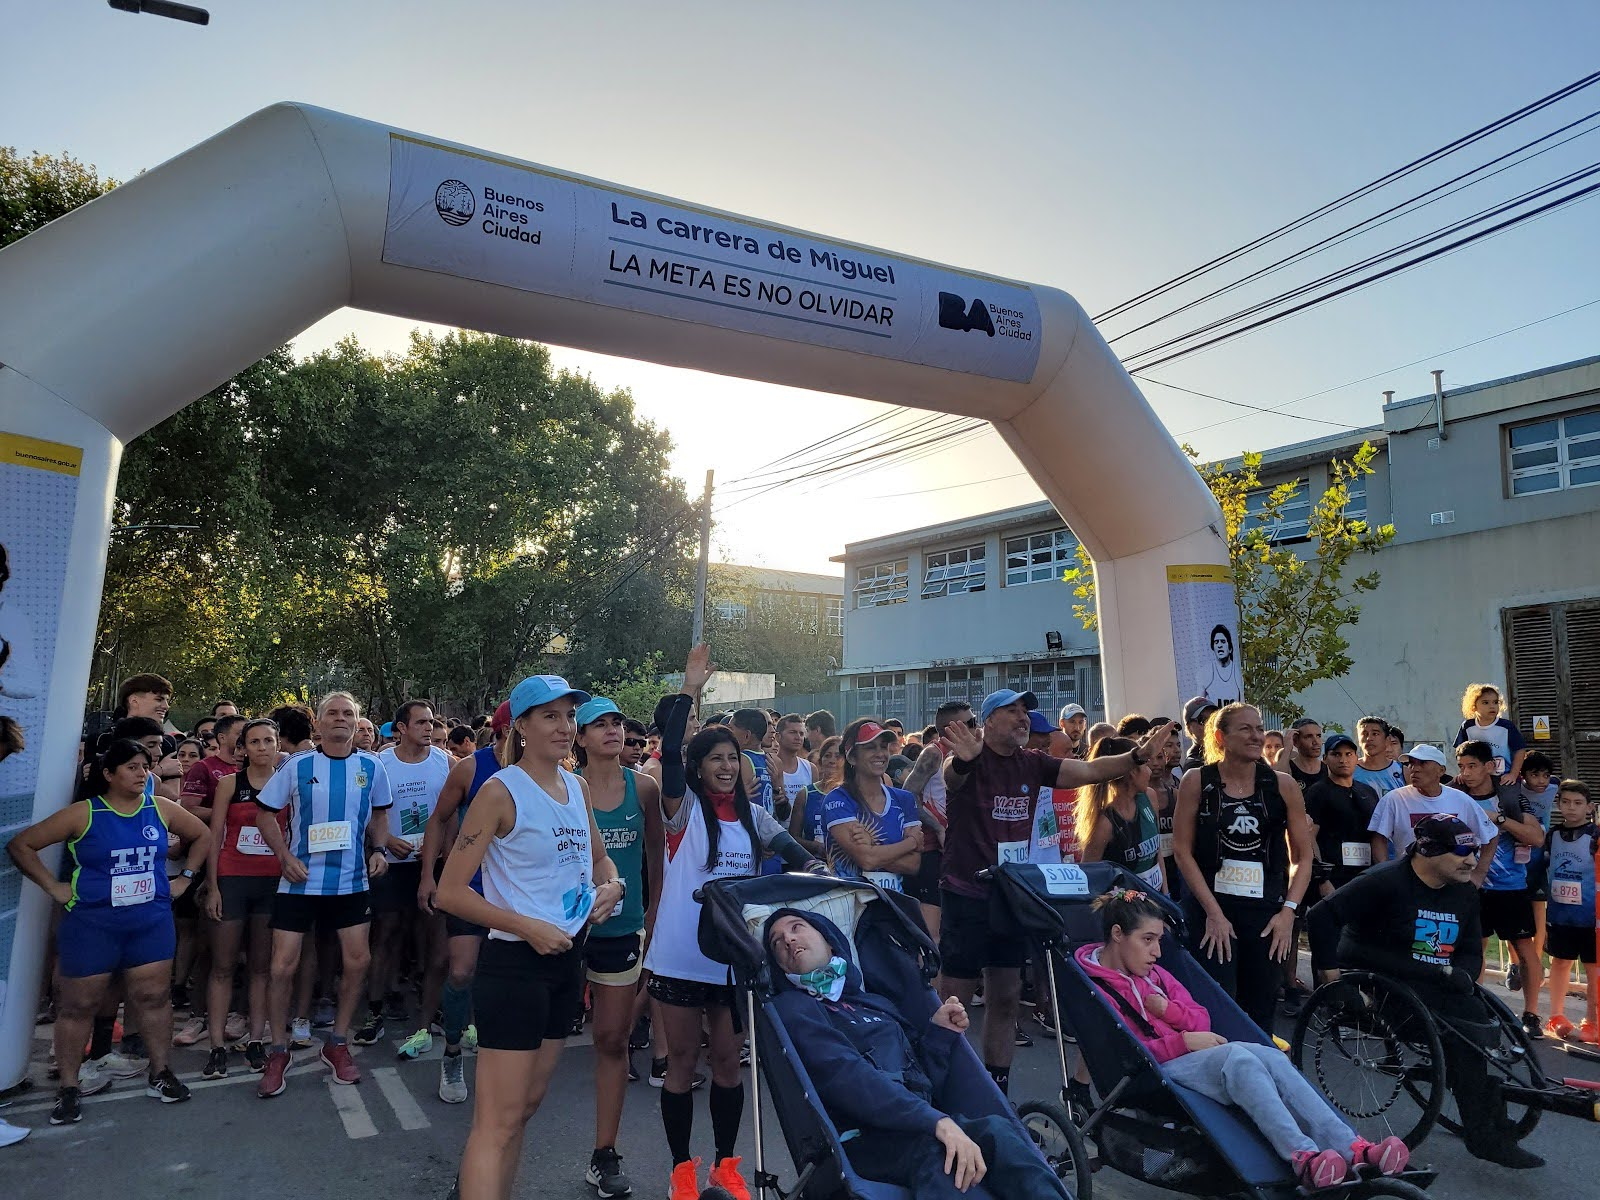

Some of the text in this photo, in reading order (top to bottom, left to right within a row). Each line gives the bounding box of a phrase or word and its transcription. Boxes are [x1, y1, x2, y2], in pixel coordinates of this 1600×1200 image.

[484, 187, 545, 213] Buenos
[482, 206, 529, 225] Aires
[482, 220, 542, 245] Ciudad
[611, 202, 896, 285] La carrera de Miguel
[609, 249, 894, 327] LA META ES NO OLVIDAR
[938, 291, 996, 338] BA
[989, 303, 1025, 319] Buenos
[996, 315, 1022, 328] Aires
[998, 326, 1033, 341] Ciudad
[15, 450, 78, 468] buenosaires.gob.ar
[557, 840, 569, 852] de
[725, 850, 751, 859] carrera
[1003, 848, 1011, 863] S
[725, 860, 751, 870] Miguel
[1047, 867, 1083, 882] S 102
[114, 877, 152, 895] 3K 797
[1560, 885, 1579, 897] 878
[1417, 909, 1460, 923] MIGUEL
[1412, 952, 1451, 966] SANCHEZ
